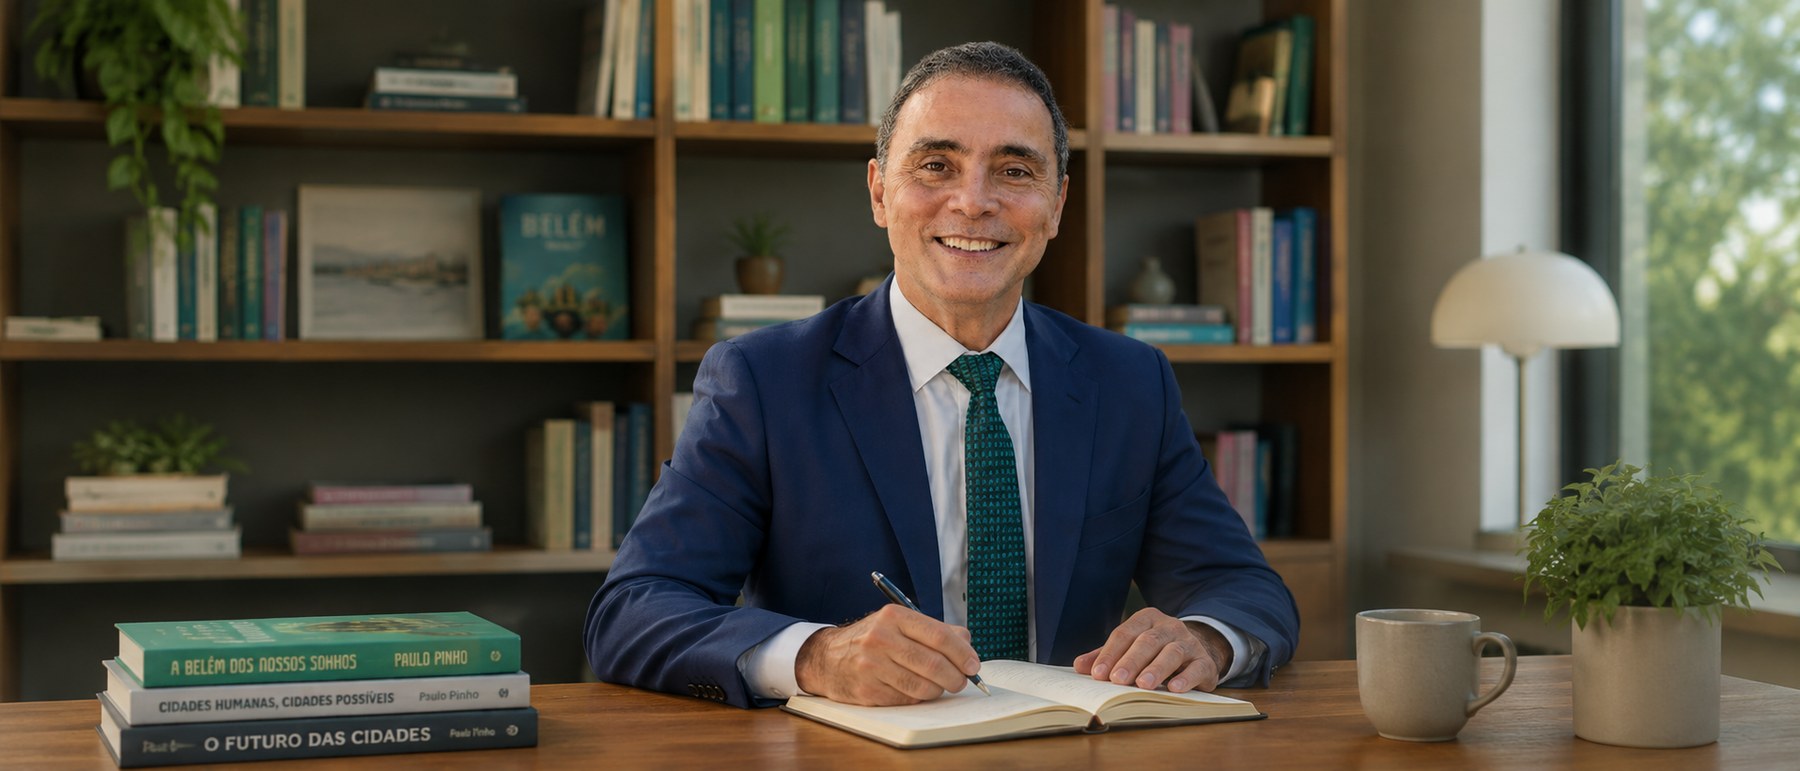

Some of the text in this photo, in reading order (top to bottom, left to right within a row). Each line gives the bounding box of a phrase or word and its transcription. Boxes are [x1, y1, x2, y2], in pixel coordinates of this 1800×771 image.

[520, 209, 605, 238] BELÉM
[171, 660, 179, 676] A
[185, 656, 225, 675] BELÉM
[230, 658, 253, 673] DOS
[394, 650, 468, 667] PAULO PINHO
[159, 690, 394, 713] CIDADES HUMANAS, CIDADES POSSÍVEIS
[419, 690, 479, 702] Paulo Pinho
[204, 737, 220, 752] O
[225, 733, 302, 751] FUTURO
[308, 731, 346, 747] DAS
[351, 727, 431, 745] CIDADES
